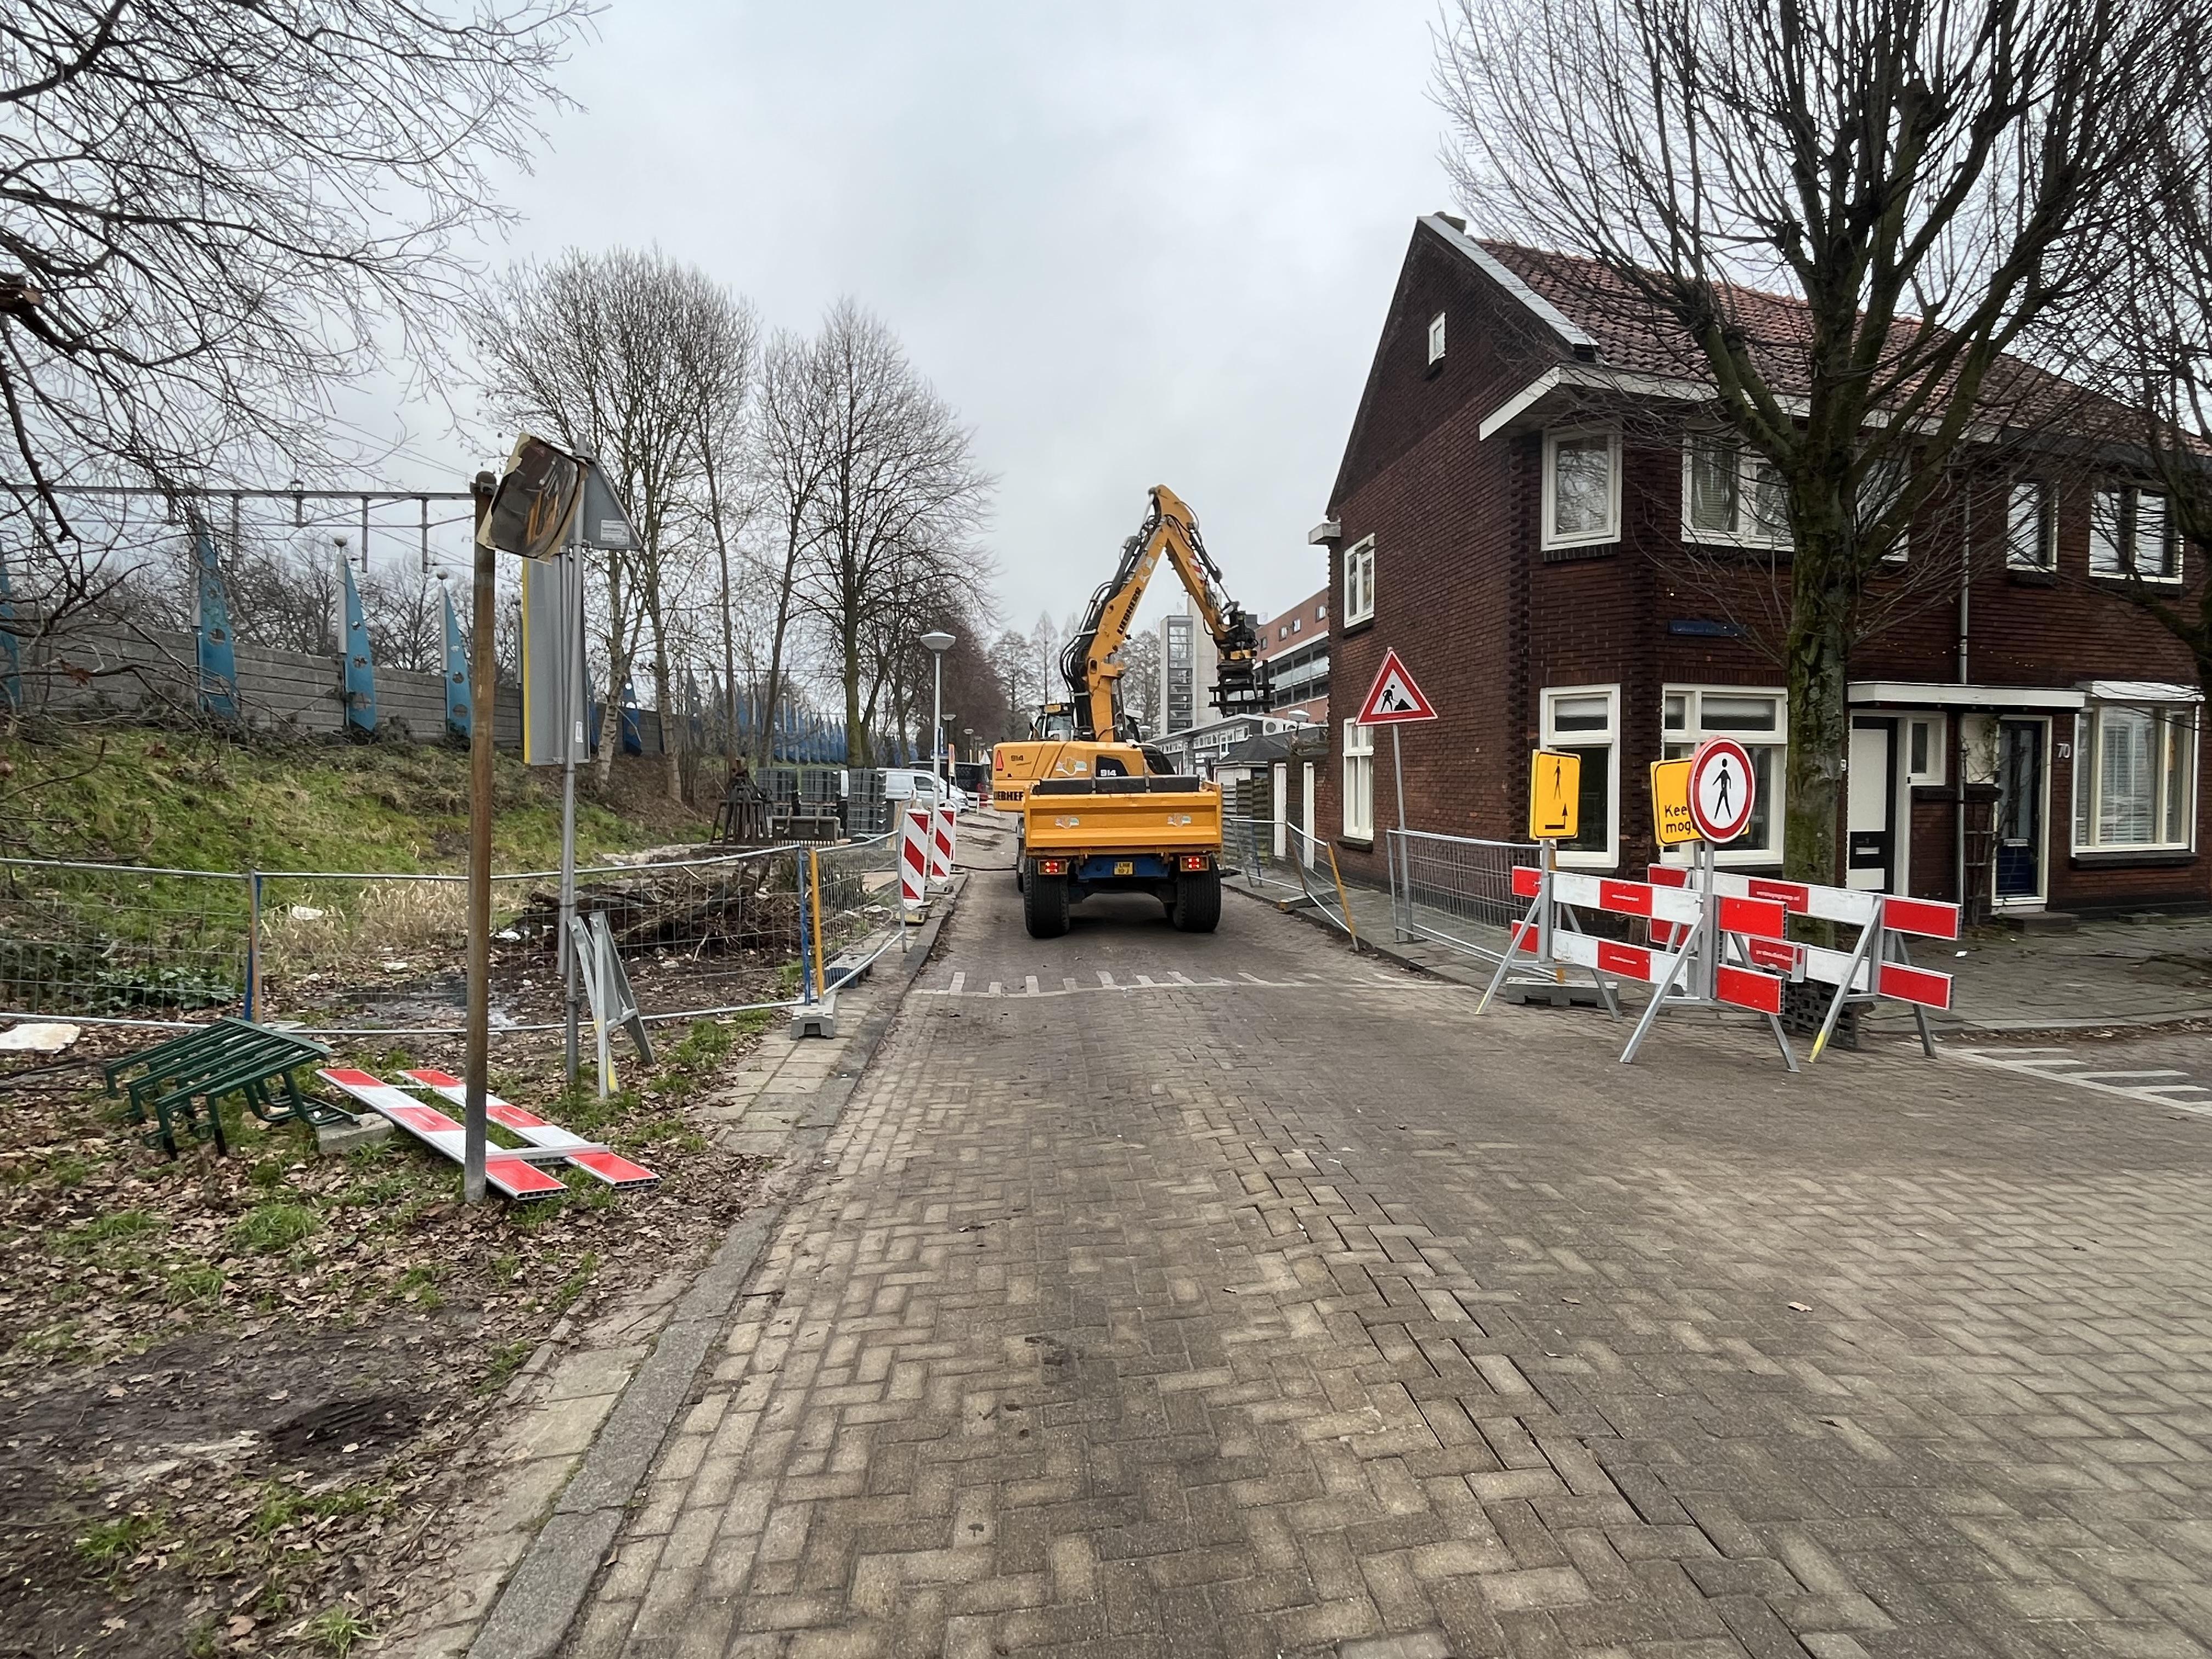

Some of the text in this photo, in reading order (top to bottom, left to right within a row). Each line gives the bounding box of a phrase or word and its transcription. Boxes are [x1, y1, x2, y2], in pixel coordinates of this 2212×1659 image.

[1117, 586, 1142, 635] LIEBHERR
[2057, 743, 2070, 758] 70
[1664, 804, 1688, 818] Kee
[1666, 821, 1695, 835] mog
